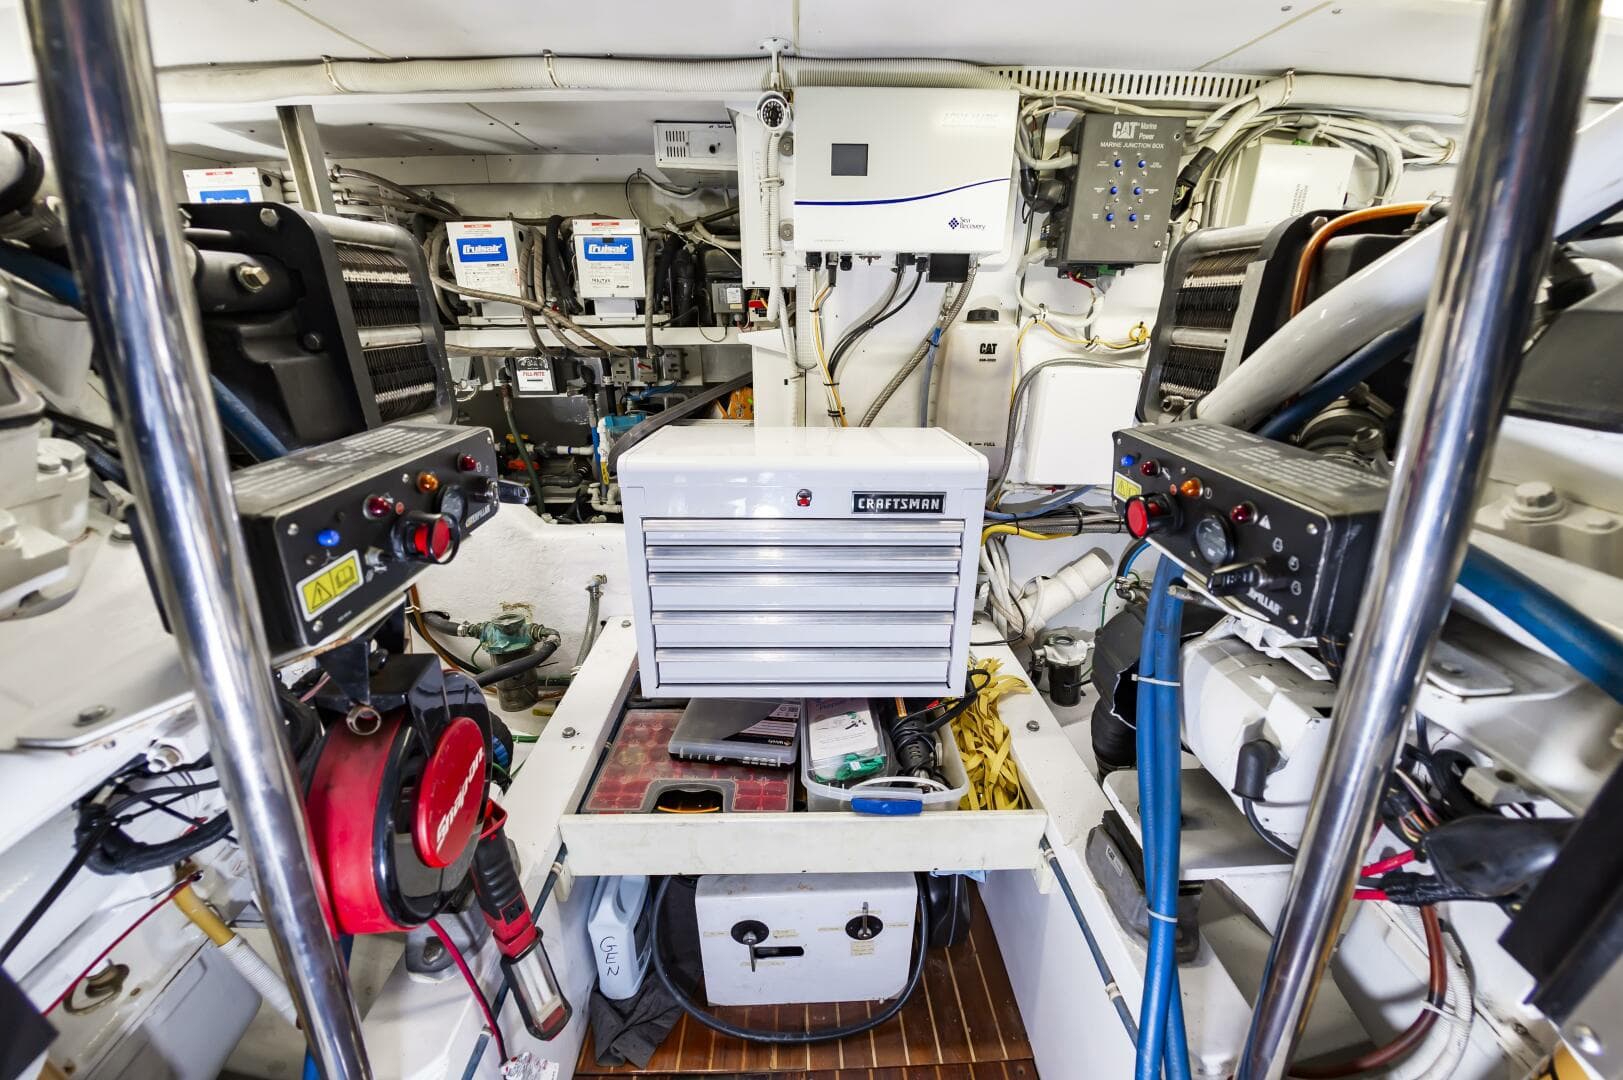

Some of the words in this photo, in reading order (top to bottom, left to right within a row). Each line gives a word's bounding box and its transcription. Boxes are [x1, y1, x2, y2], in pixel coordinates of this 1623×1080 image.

[1112, 121, 1139, 139] CAT
[1138, 132, 1155, 140] Power
[979, 343, 998, 355] CAT
[858, 498, 940, 510] CRAFTSMAN
[600, 935, 620, 976] GEN
